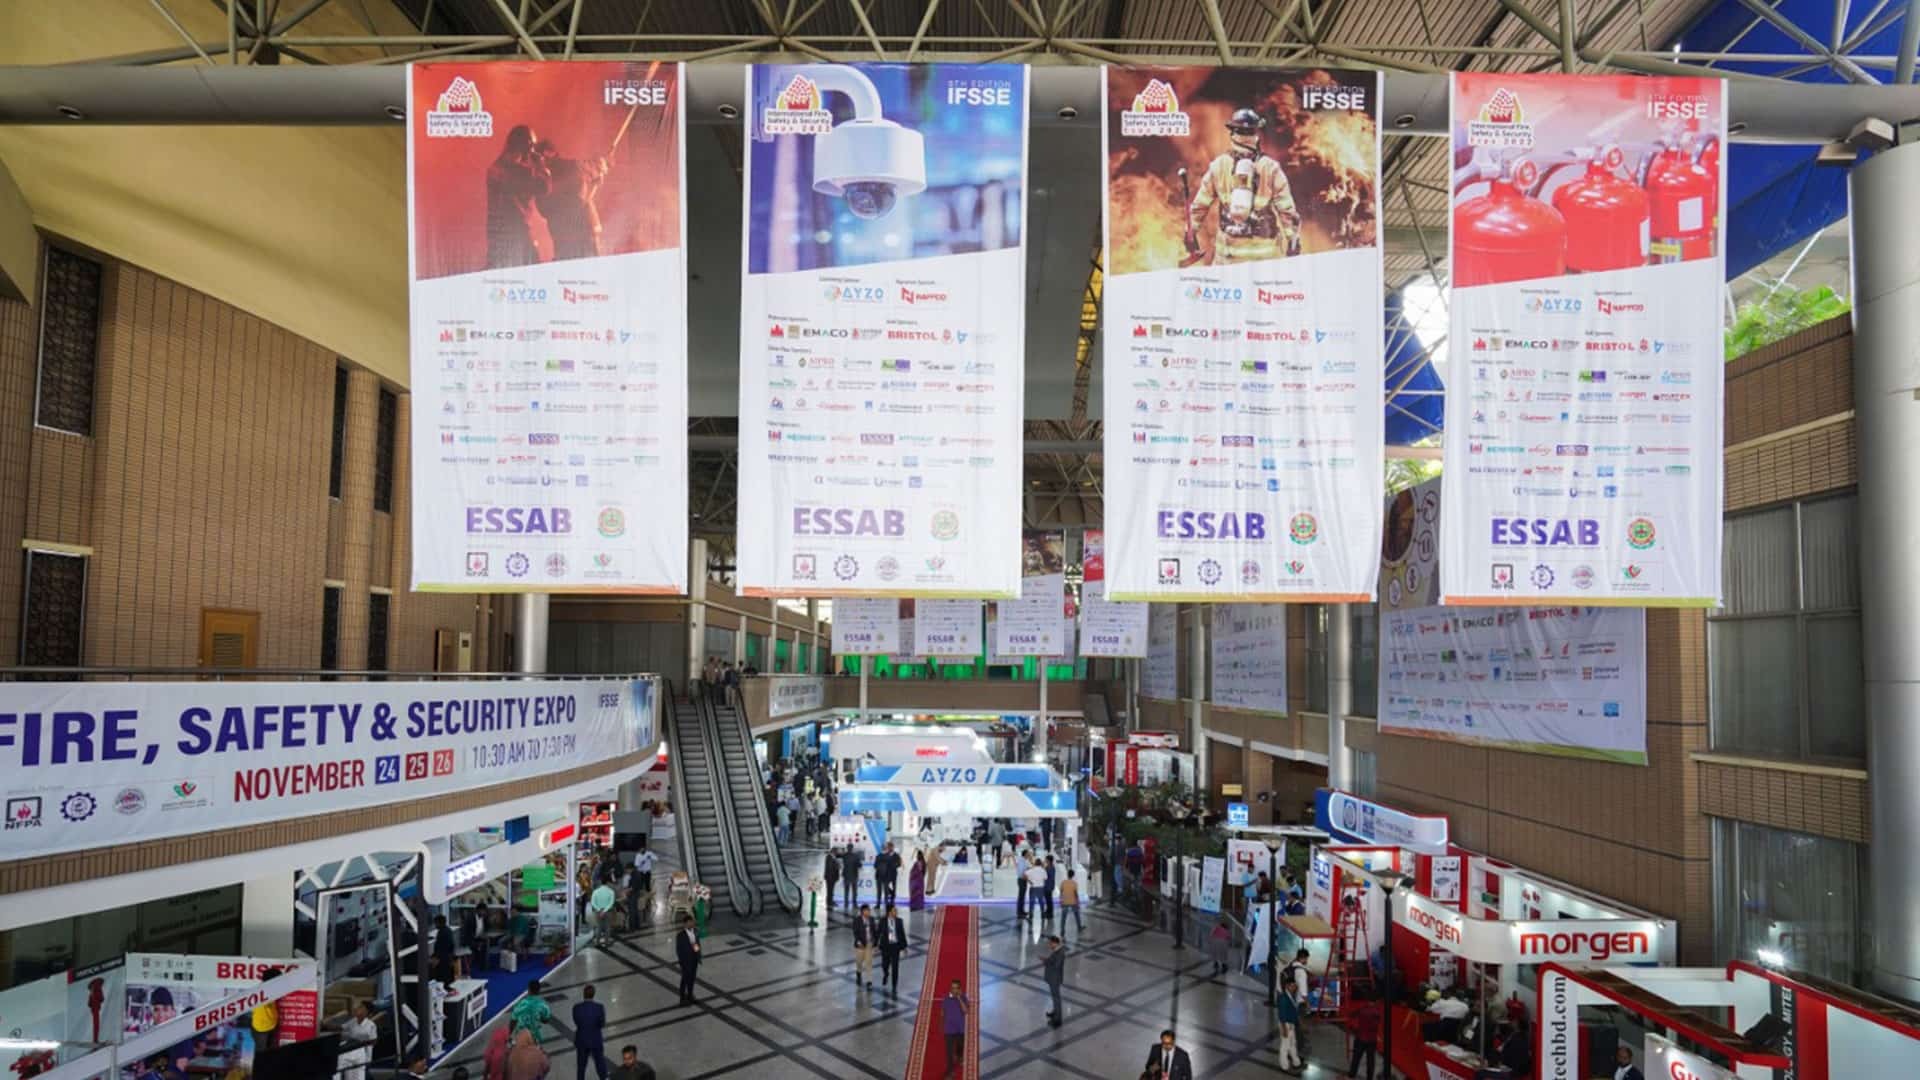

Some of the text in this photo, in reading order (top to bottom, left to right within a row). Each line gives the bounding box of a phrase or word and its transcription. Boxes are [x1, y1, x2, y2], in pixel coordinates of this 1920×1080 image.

[970, 80, 1011, 88] EDITION
[1326, 85, 1365, 94] EDITION
[604, 87, 666, 105] IFSSE
[947, 87, 1011, 105] IFSSE
[1303, 92, 1365, 110] IFSSE
[1647, 102, 1709, 119] IFSSE
[507, 288, 547, 301] AYZO
[842, 287, 884, 299] AYZO
[1203, 288, 1242, 300] AYZO
[1543, 299, 1581, 311] AYZO
[470, 331, 514, 341] EMACO
[551, 331, 601, 341] BRISTOL
[802, 328, 849, 339] EMACO
[887, 330, 938, 341] BRISTOL
[1165, 327, 1209, 338] EMACO
[1246, 331, 1296, 341] BRISTOL
[1505, 339, 1548, 349] EMACO
[1585, 341, 1635, 351] BRISTOL
[466, 507, 572, 534] ESSAB
[793, 507, 905, 537] ESSAB
[1157, 510, 1266, 540] ESSAB
[1491, 518, 1600, 546] ESSAB
[177, 703, 363, 756] SAFETY
[370, 702, 397, 742] &
[406, 698, 530, 739] SECURITY
[534, 694, 576, 727] EXPO
[234, 733, 577, 804] NOVEMBER 24 25 26 10:30 AM TO 7:30 PM
[921, 767, 977, 783] AYZO
[4, 818, 42, 831] NFPA
[1408, 905, 1461, 946] morgen
[1519, 931, 1649, 961] morgen
[194, 990, 269, 1031] BRISTOL
